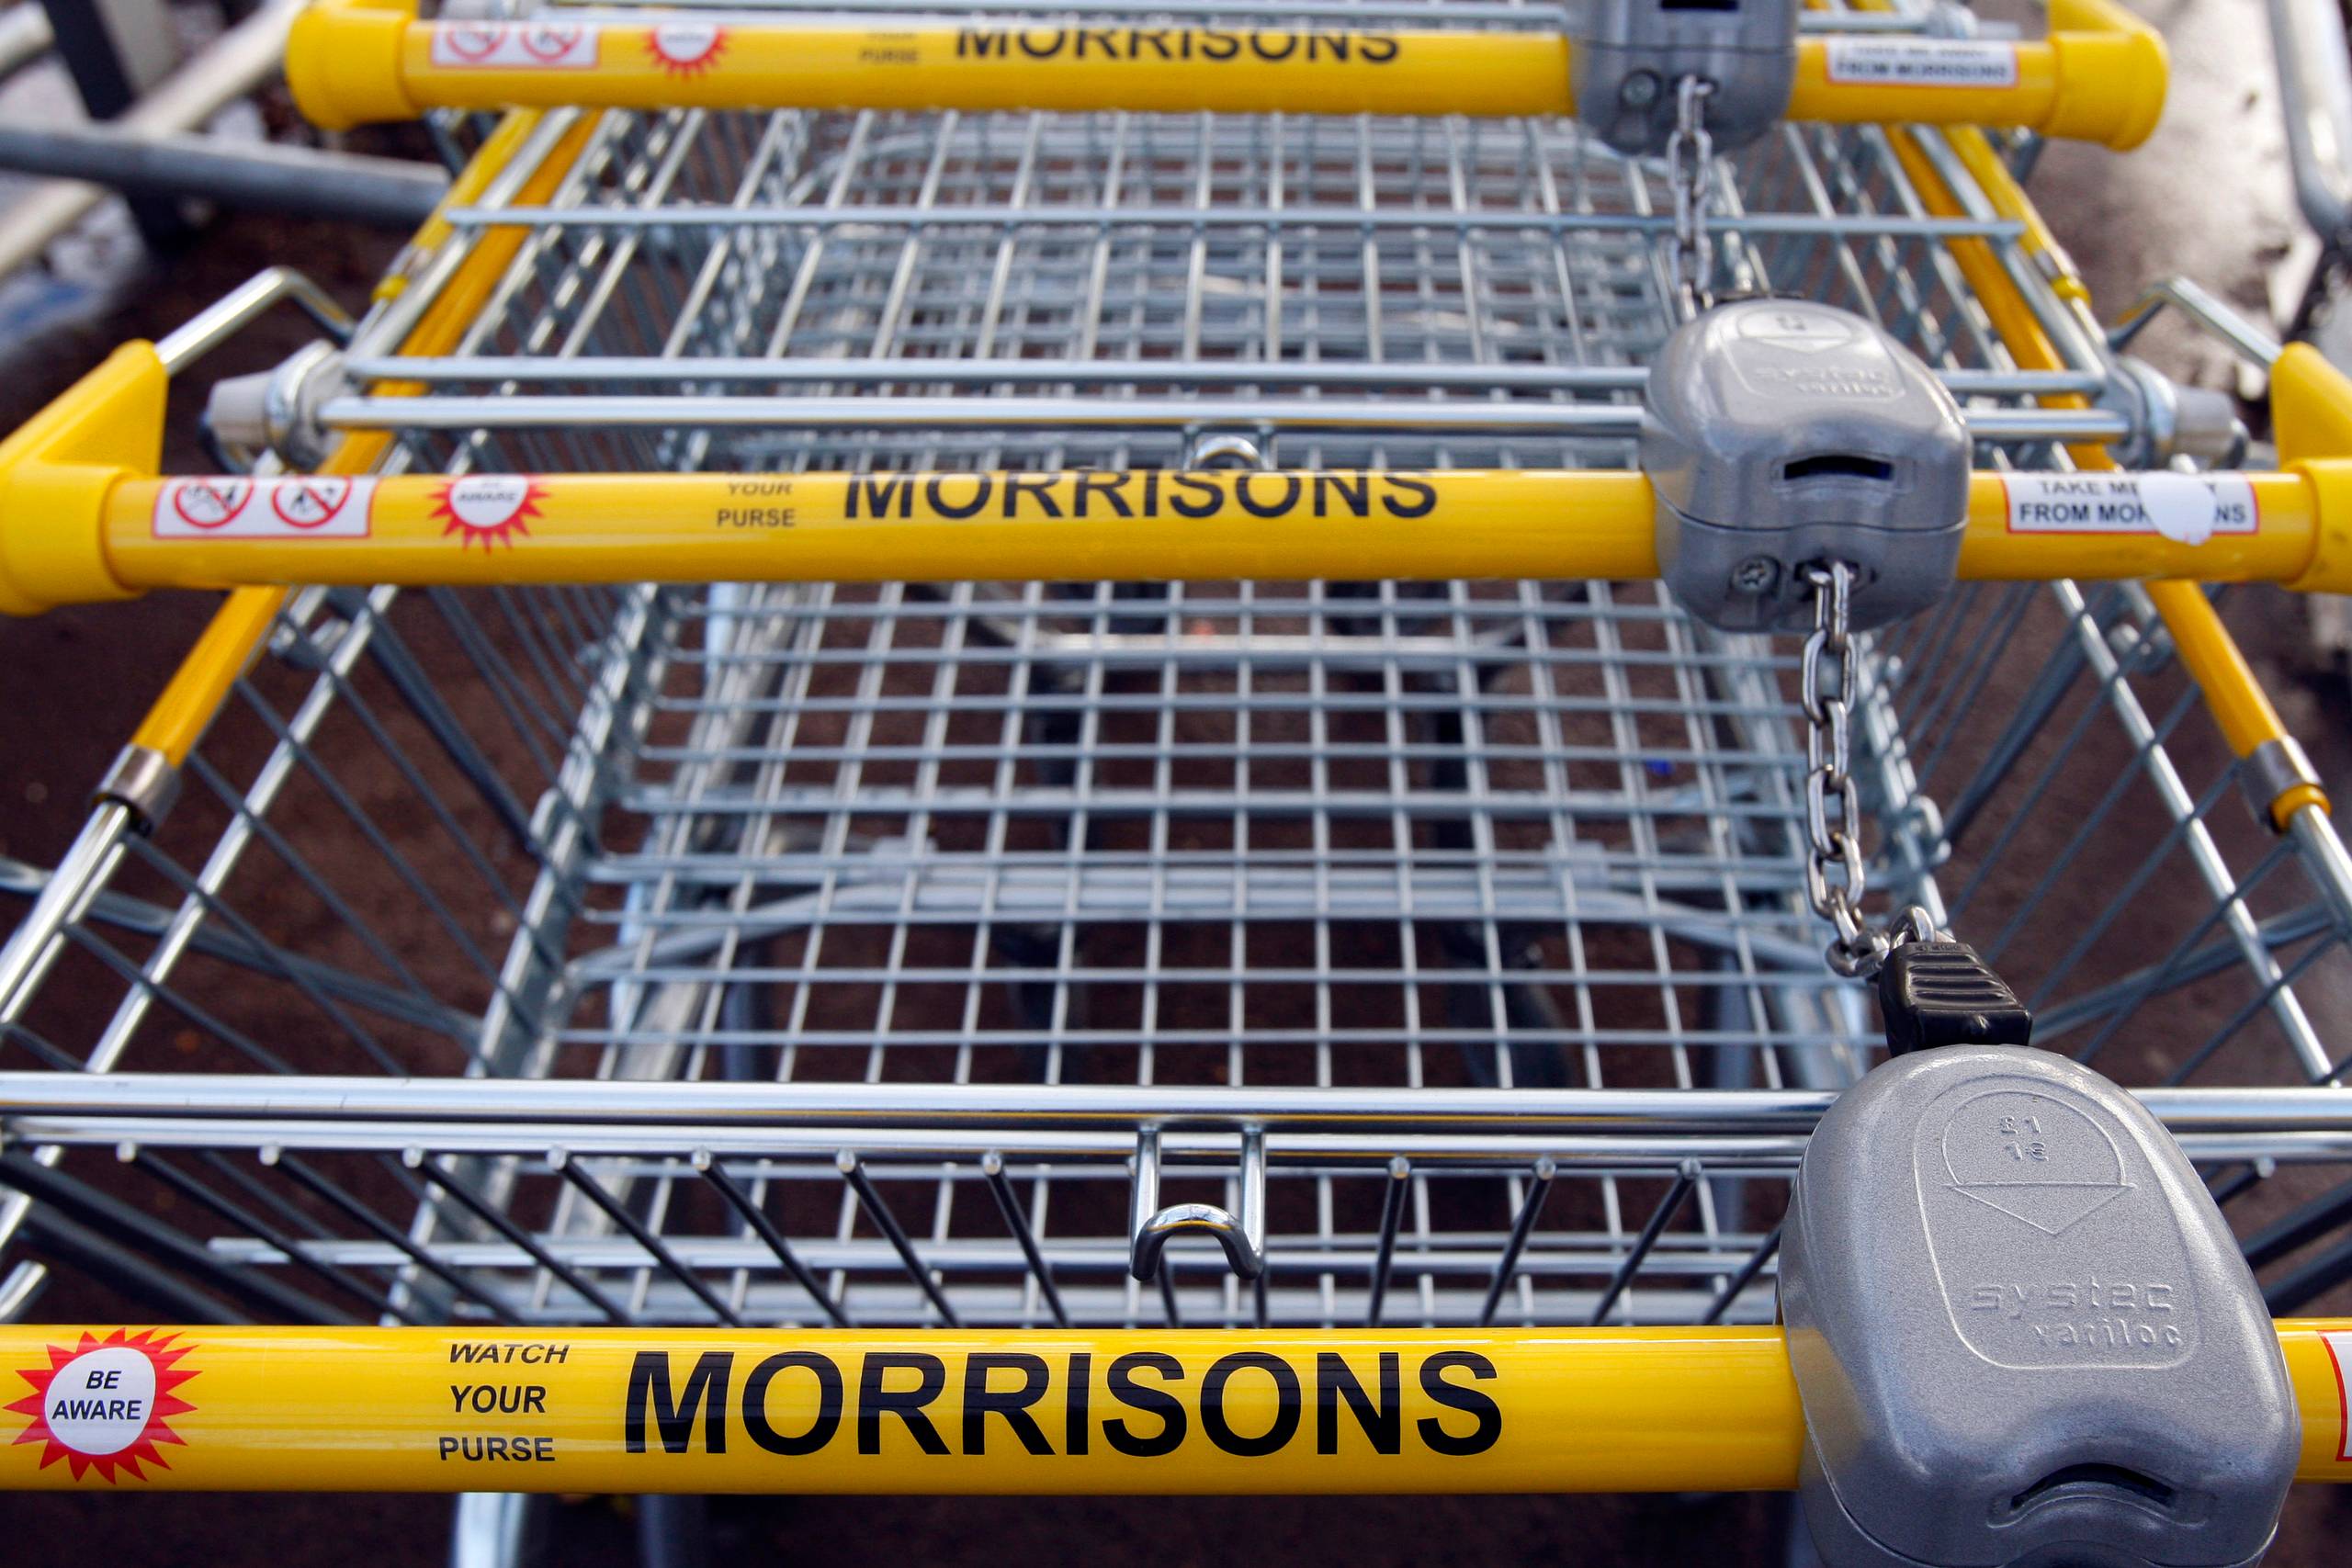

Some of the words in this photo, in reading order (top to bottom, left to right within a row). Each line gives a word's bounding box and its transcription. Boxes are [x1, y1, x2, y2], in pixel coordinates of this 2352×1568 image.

[957, 28, 1397, 62] MORRISONS
[729, 481, 793, 496] YOUR
[844, 469, 1438, 518] MORRISONS
[2040, 479, 2102, 496] TAKE
[717, 508, 797, 528] PURSE
[2019, 503, 2090, 525] FROM
[1972, 1277, 2173, 1320] systec
[449, 1343, 570, 1364] WATCH
[85, 1371, 122, 1390] BE
[51, 1400, 142, 1420] AWARE
[450, 1385, 547, 1414] YOUR
[623, 1351, 1503, 1457] MORRISONS
[439, 1437, 556, 1461] PURSE
